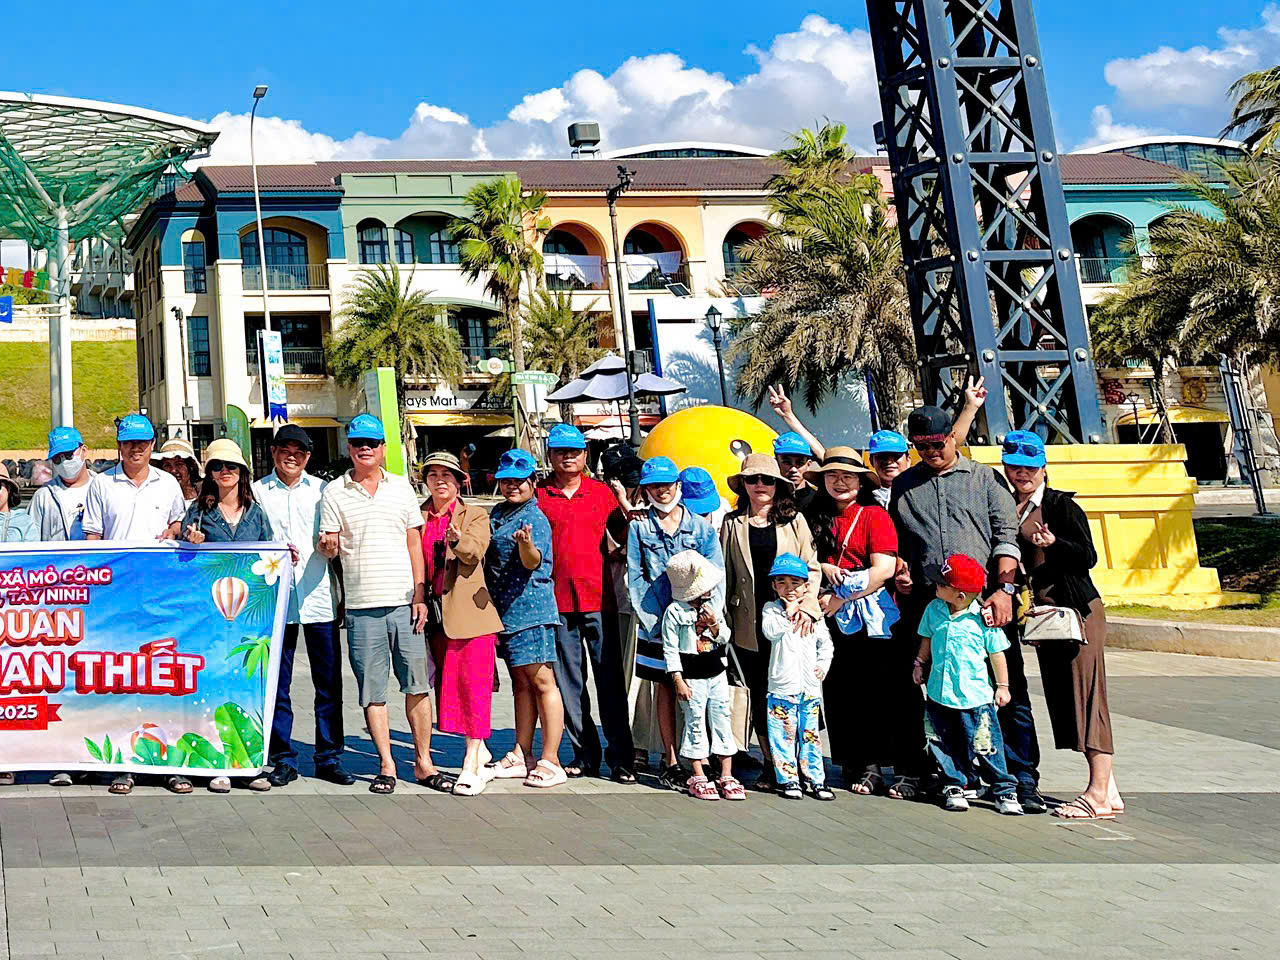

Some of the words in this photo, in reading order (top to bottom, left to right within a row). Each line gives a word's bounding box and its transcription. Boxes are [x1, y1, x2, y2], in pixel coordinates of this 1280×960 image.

[429, 394, 458, 407] Mart
[1, 569, 25, 587] XÃ
[29, 566, 59, 586] MỎ
[61, 567, 112, 585] CÔNG
[45, 587, 89, 603] NINH
[75, 640, 202, 690] THIẾT
